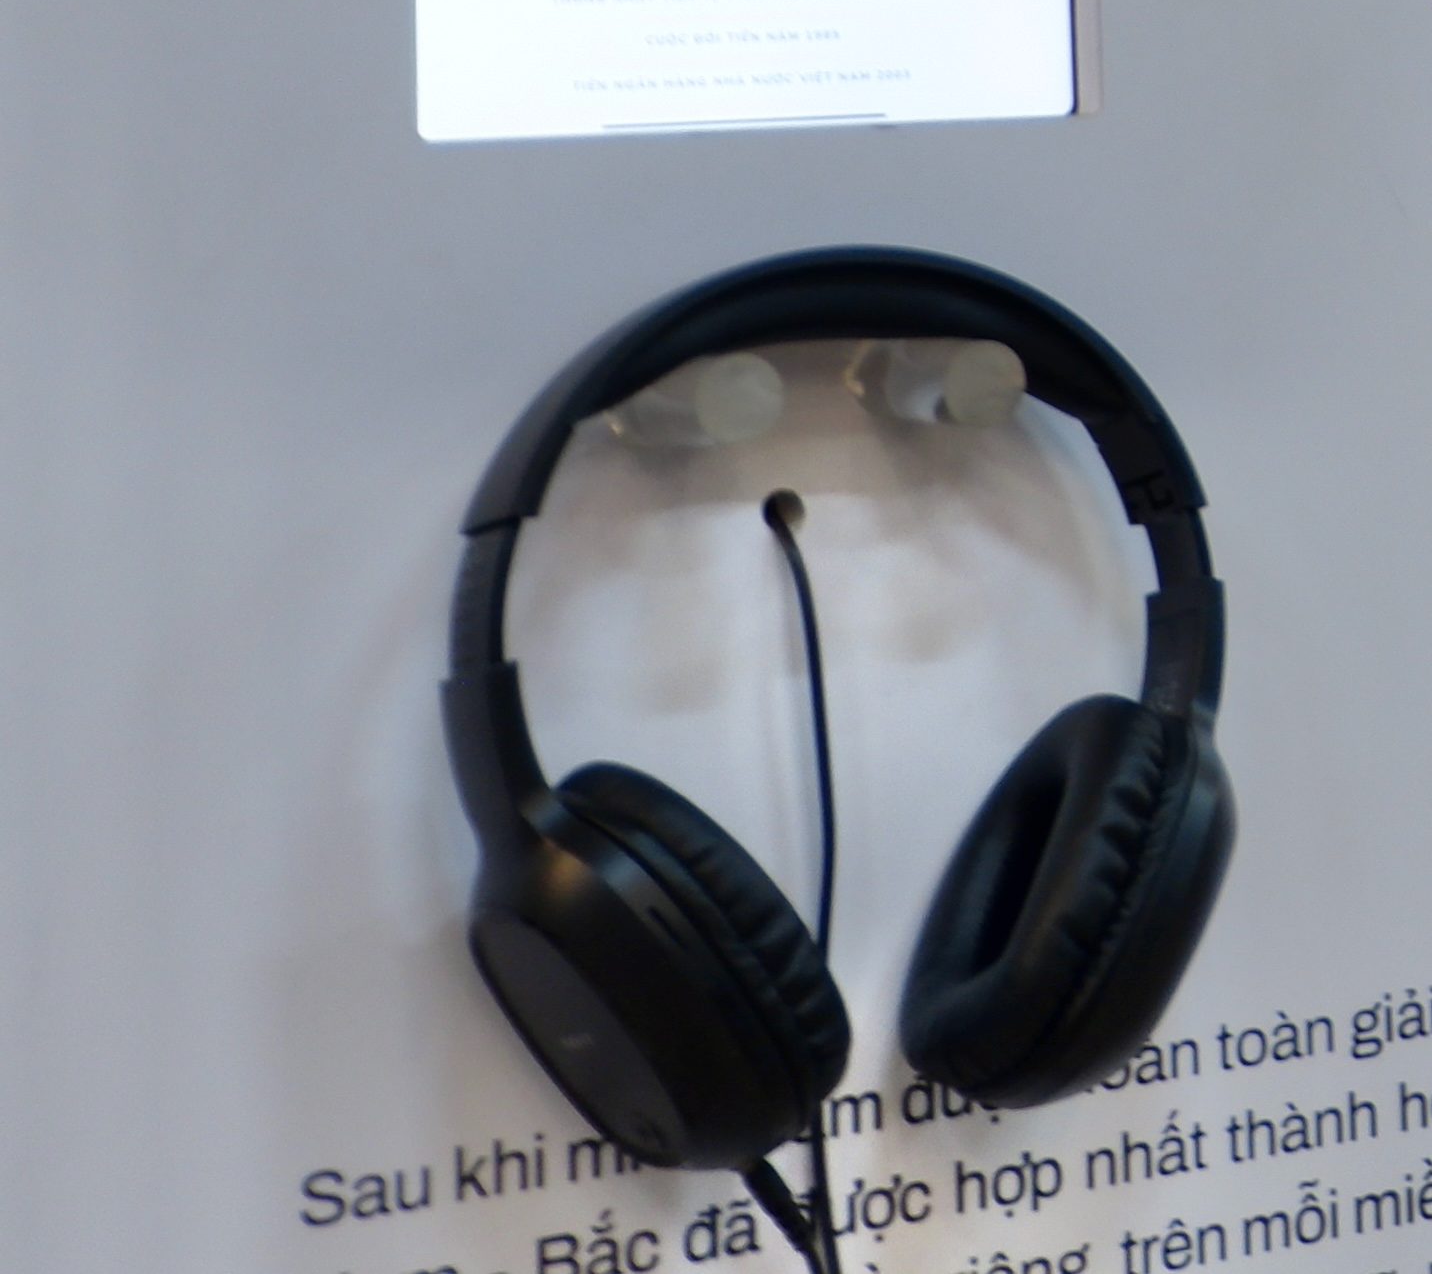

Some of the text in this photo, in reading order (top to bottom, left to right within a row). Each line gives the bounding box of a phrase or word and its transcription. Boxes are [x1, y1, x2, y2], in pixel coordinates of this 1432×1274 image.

[300, 1166, 431, 1227] Sau
[452, 1134, 548, 1201] khi
[1216, 1011, 1334, 1070] toàn
